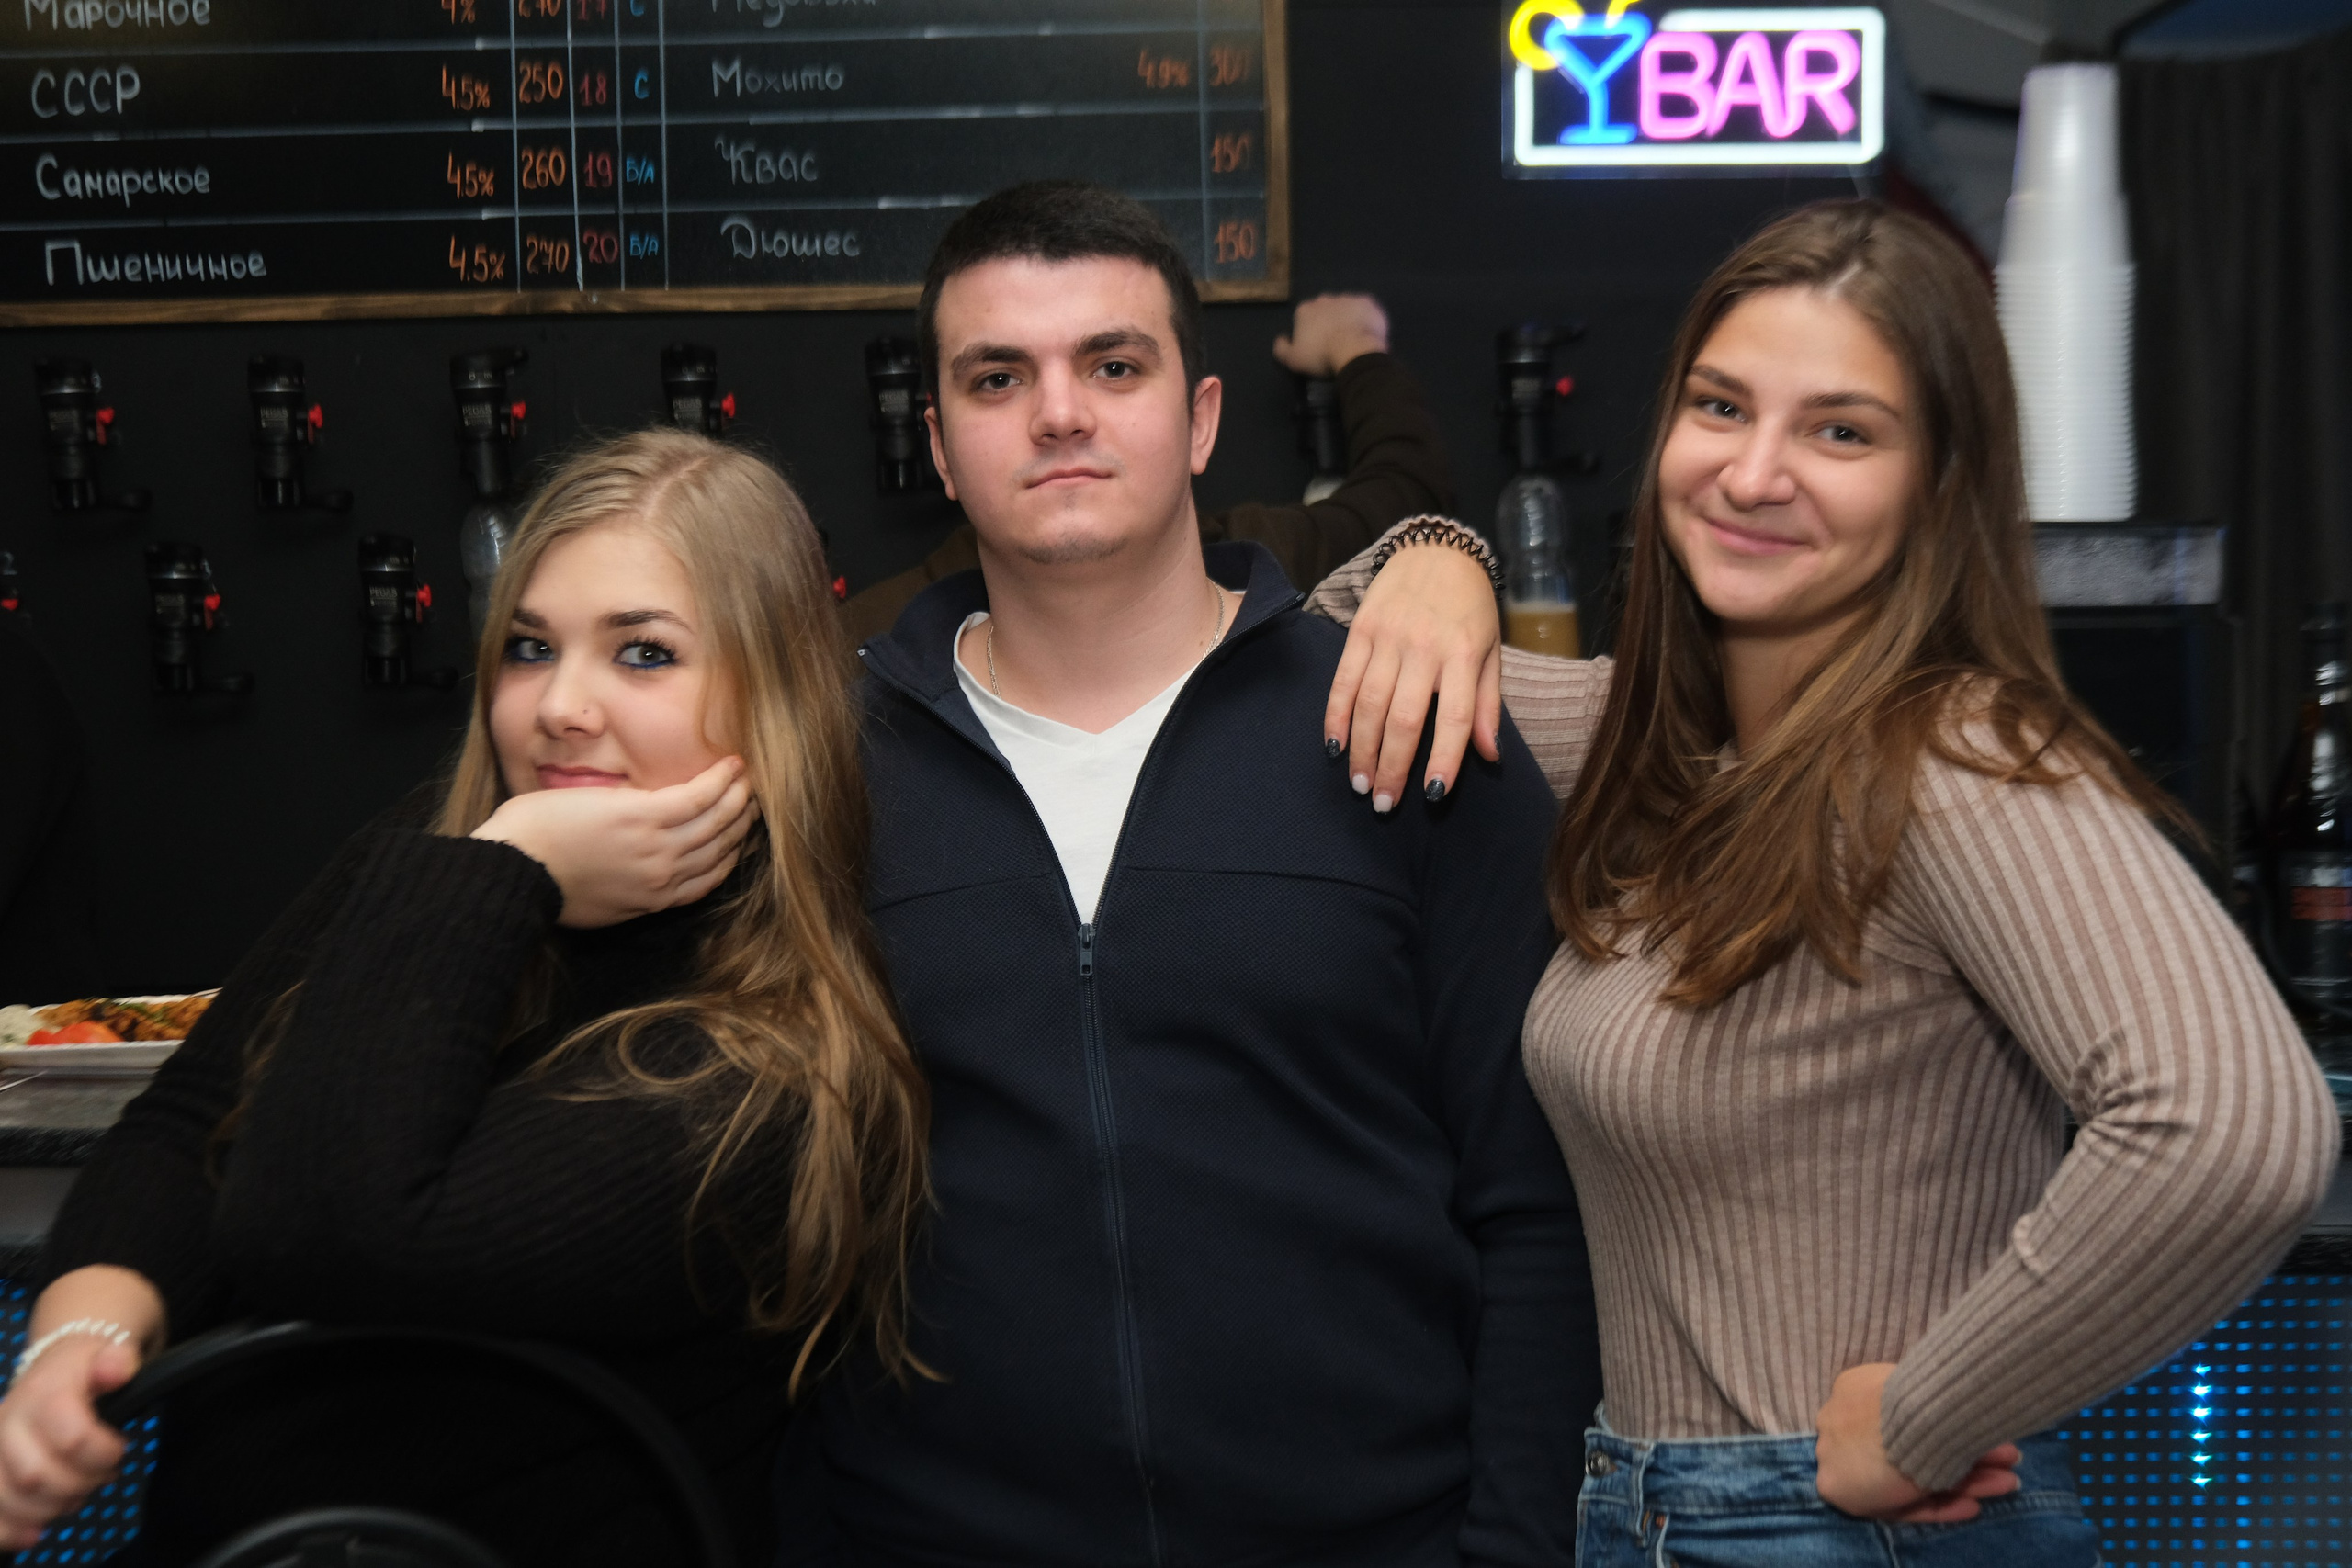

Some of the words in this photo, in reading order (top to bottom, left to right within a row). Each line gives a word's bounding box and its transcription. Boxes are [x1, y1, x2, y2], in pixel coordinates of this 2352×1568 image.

[31, 64, 141, 118] СССР
[518, 59, 564, 104] 250
[579, 69, 607, 107] 18
[711, 55, 845, 98] Мохито
[1640, 30, 1860, 138] BAR
[35, 151, 211, 209] Самарское
[522, 148, 567, 190] 260
[583, 150, 613, 189] 19
[715, 135, 818, 185] Квас
[45, 237, 267, 287] Пшеничное
[448, 233, 506, 283] 4.5%
[526, 232, 570, 276] 270
[582, 226, 619, 265] 20
[720, 214, 860, 260] Дюшес
[1215, 220, 1257, 264] 150
